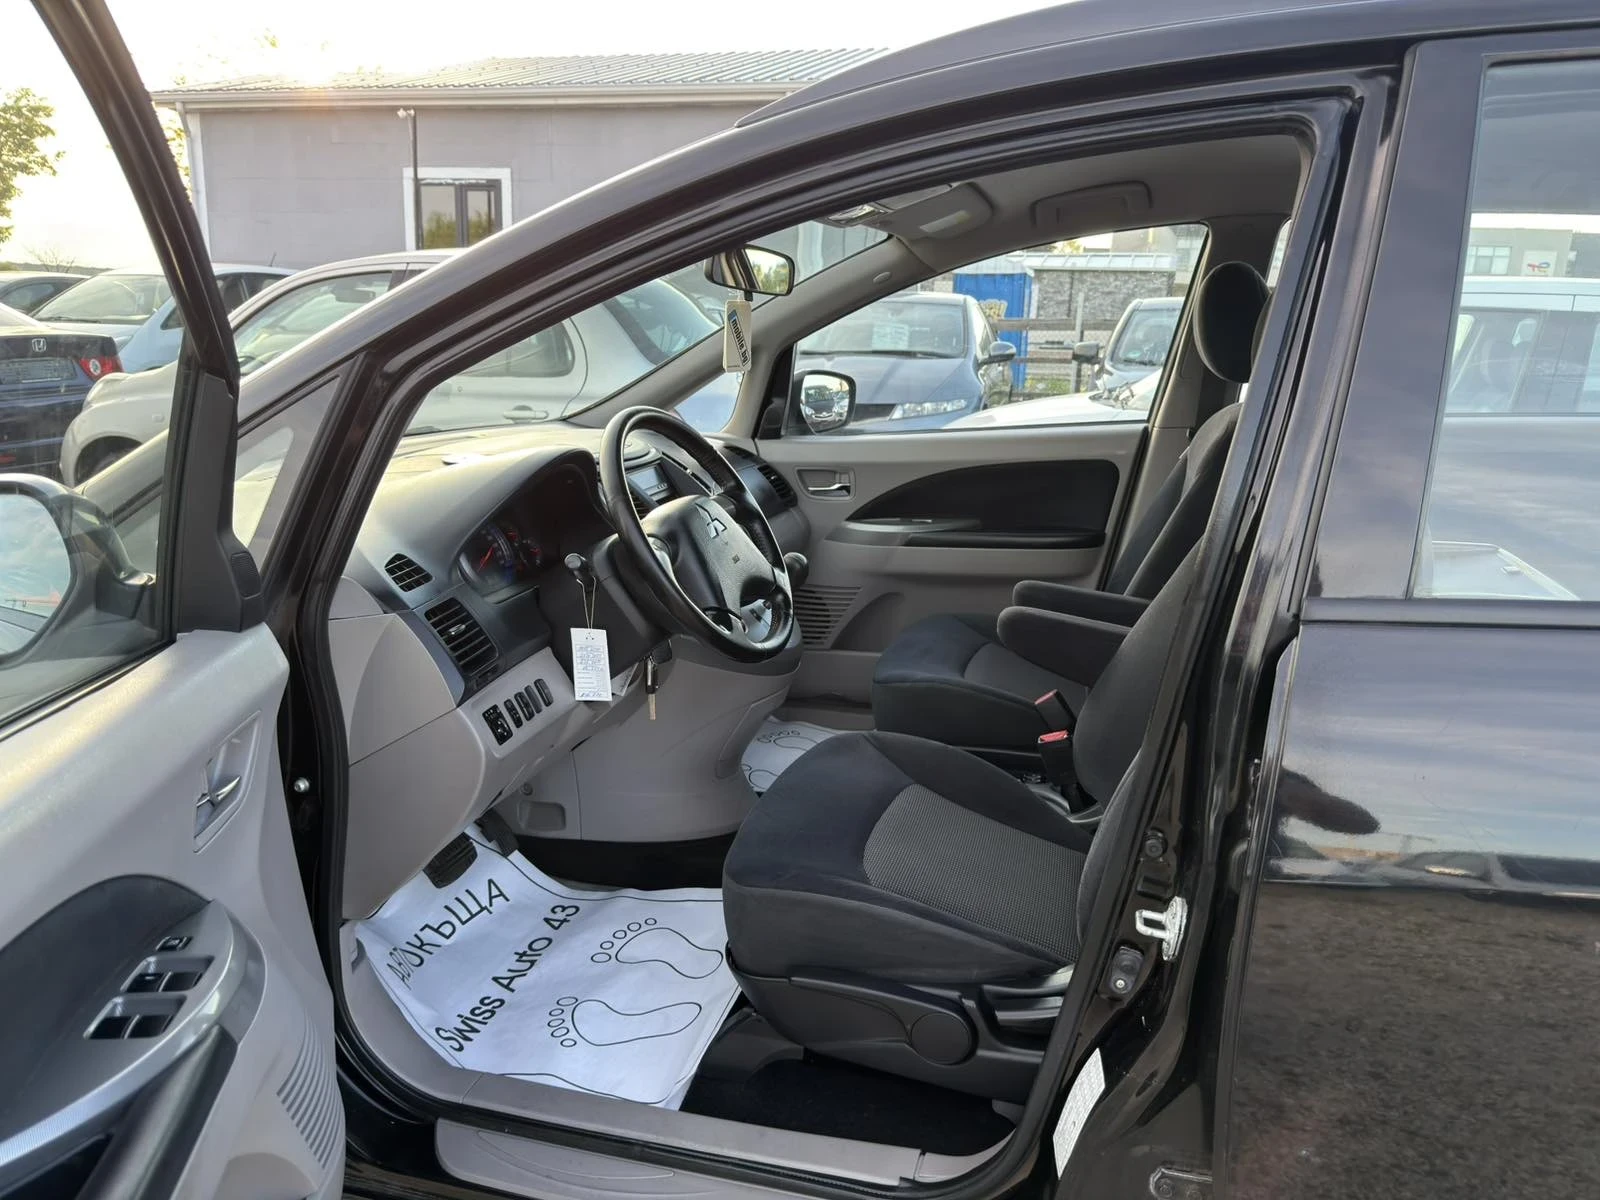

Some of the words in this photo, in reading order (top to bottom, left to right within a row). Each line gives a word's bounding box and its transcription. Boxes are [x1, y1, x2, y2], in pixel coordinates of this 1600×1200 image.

[435, 996, 506, 1052] Swiss
[491, 937, 553, 993] Auto
[543, 904, 580, 930] 43
